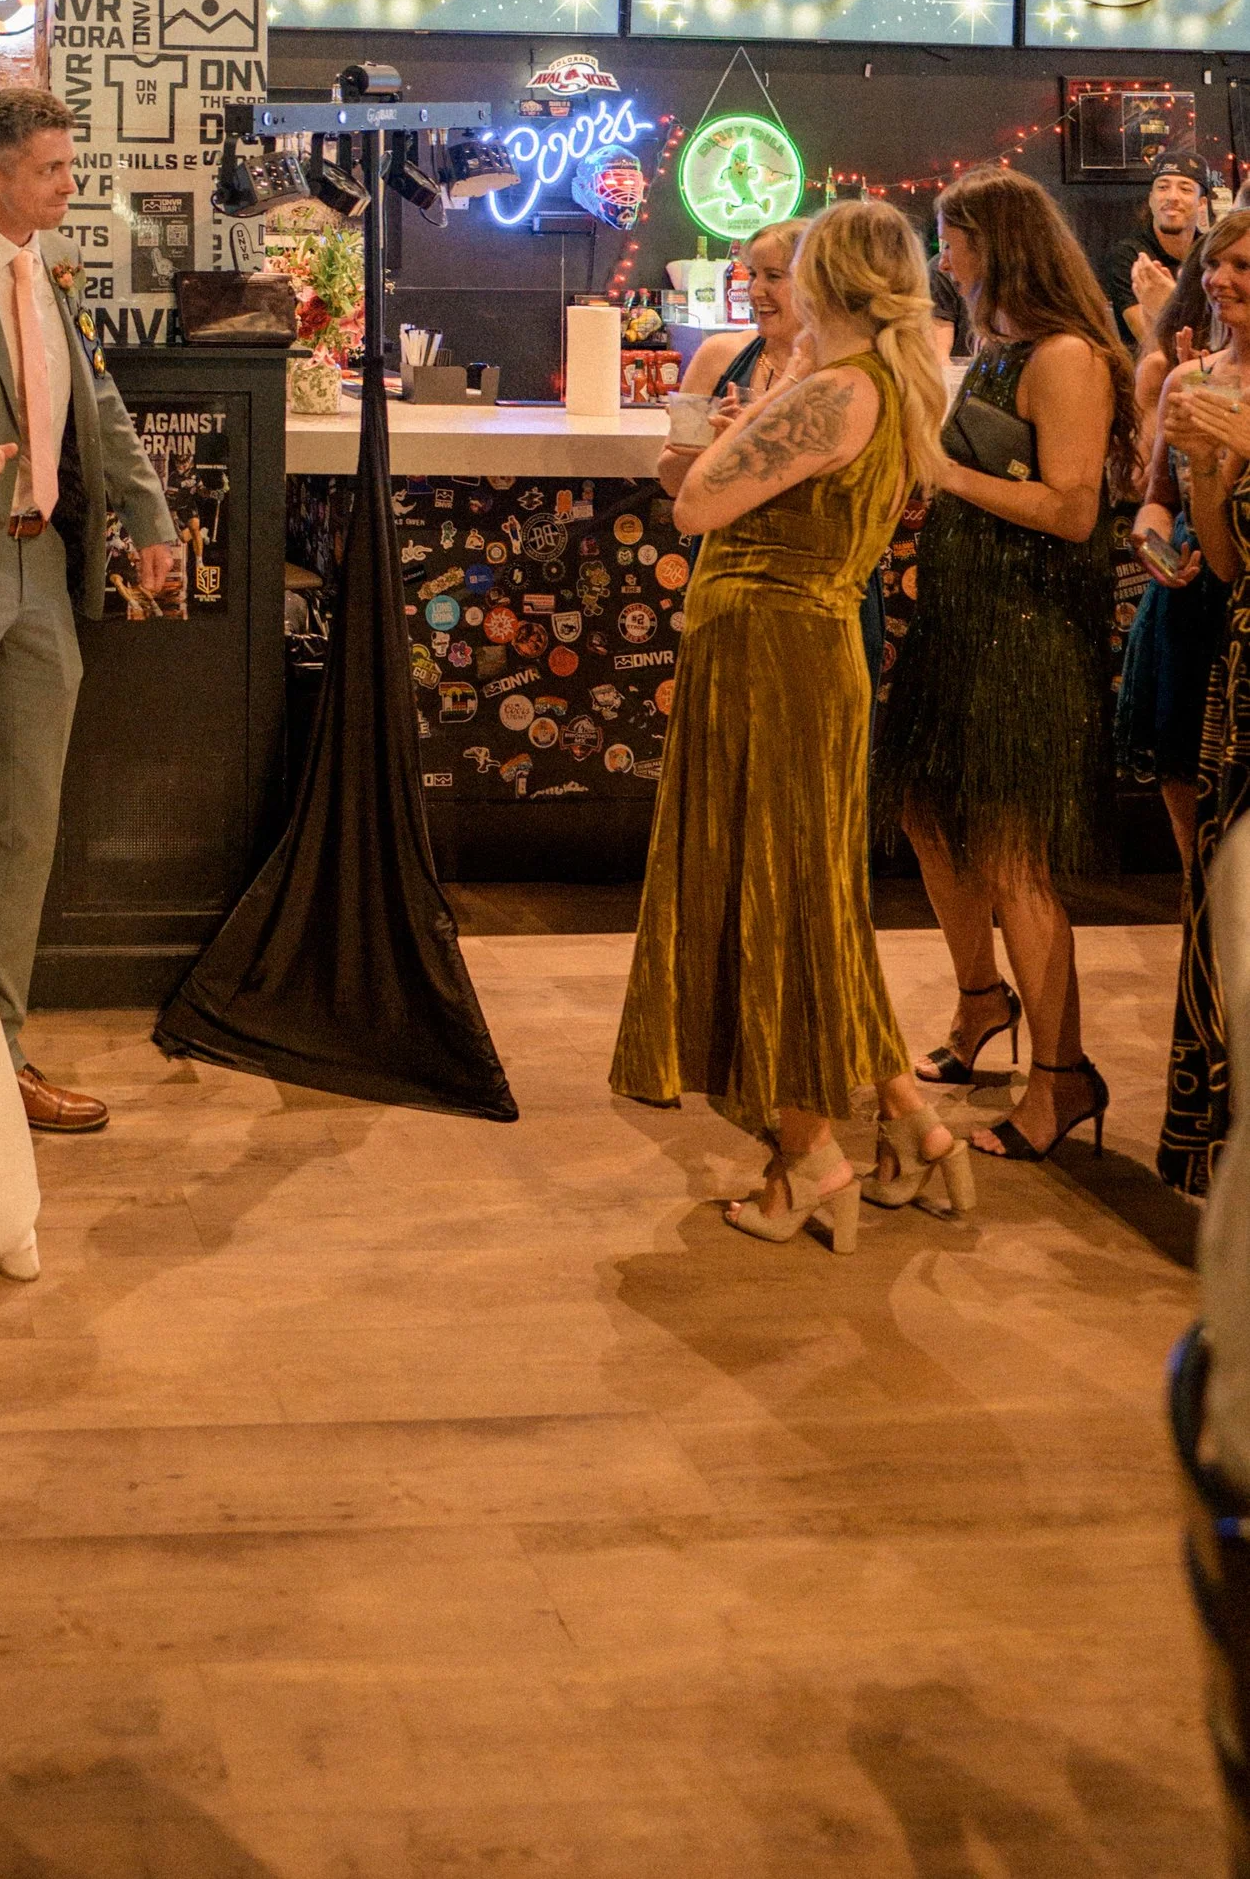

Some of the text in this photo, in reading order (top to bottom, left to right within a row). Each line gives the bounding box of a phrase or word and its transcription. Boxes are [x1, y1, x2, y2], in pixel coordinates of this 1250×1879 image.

[52, 26, 125, 49] RORA
[550, 55, 597, 71] COLORADO
[136, 79, 157, 92] DN
[136, 93, 157, 105] VR
[201, 95, 231, 108] THE
[119, 154, 178, 170] HILLS
[482, 98, 654, 225] Coors
[236, 230, 249, 261] DNVR
[144, 413, 227, 434] AGAINST
[141, 435, 196, 455] GRAIN
[633, 650, 675, 667] DNVR
[500, 668, 541, 692] DNVR
[503, 704, 531, 715] Coors
